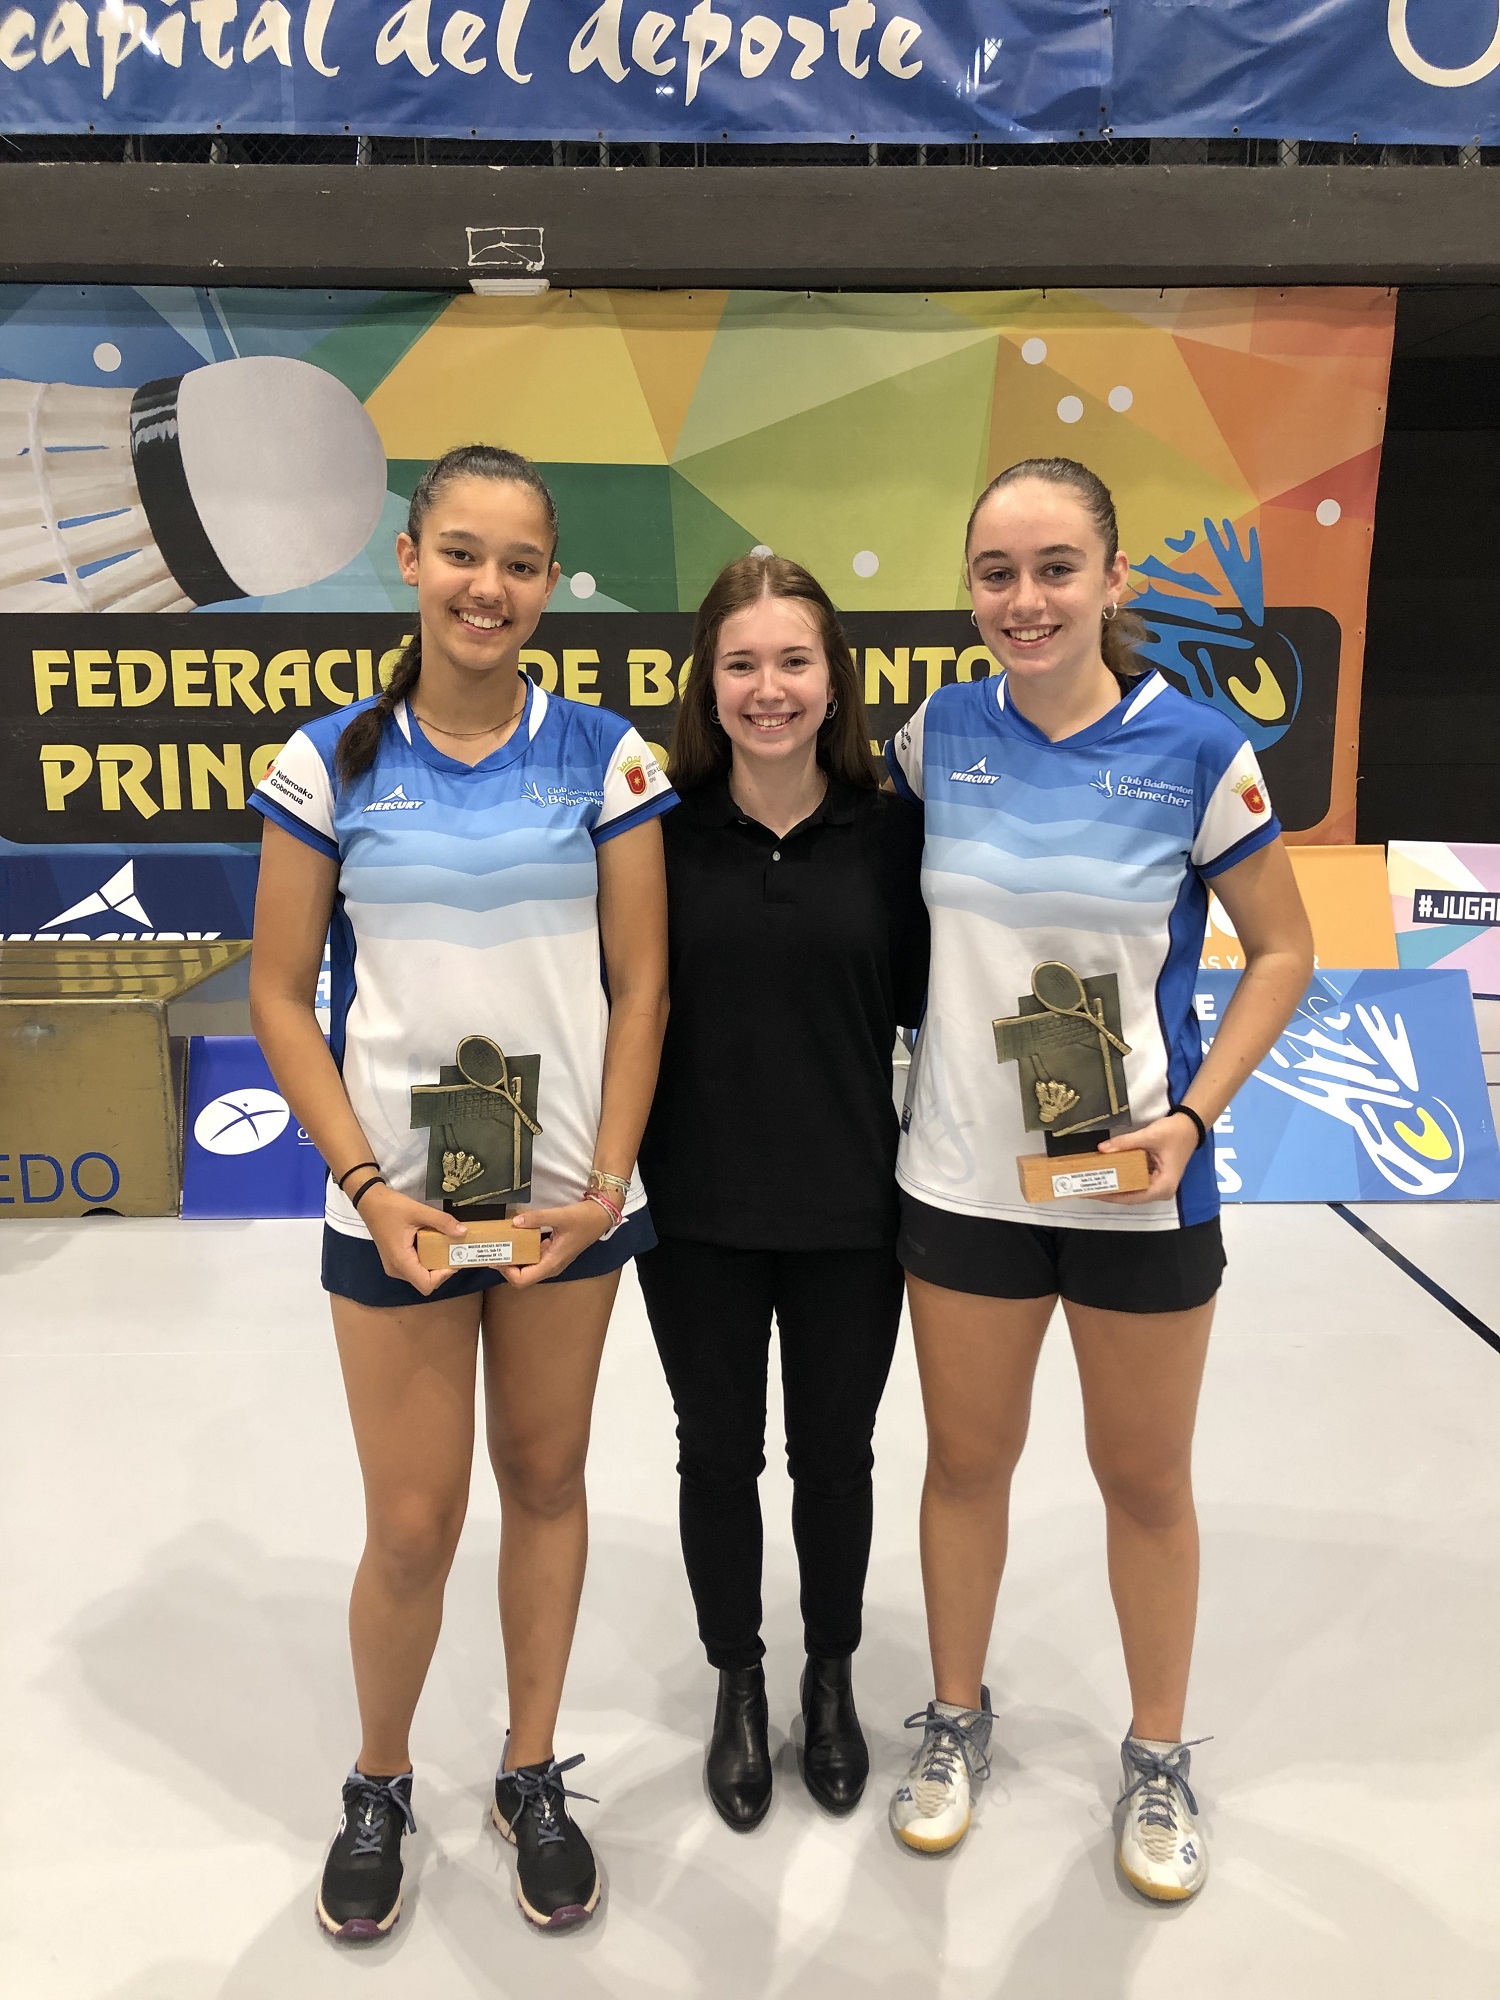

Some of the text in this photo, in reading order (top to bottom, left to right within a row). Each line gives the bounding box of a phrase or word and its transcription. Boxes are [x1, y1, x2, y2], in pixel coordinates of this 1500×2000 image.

[0, 0, 923, 106] capital del deporte
[32, 635, 415, 715] FEDERACI
[518, 649, 603, 706] DE
[276, 770, 313, 800] Nafarroako
[951, 772, 1000, 784] MERCURY
[1120, 775, 1142, 786] Club
[270, 779, 304, 805] Gobernua
[1117, 784, 1191, 808] Belmecher
[362, 800, 422, 813] MERCURY
[1418, 894, 1500, 921] #JUGA
